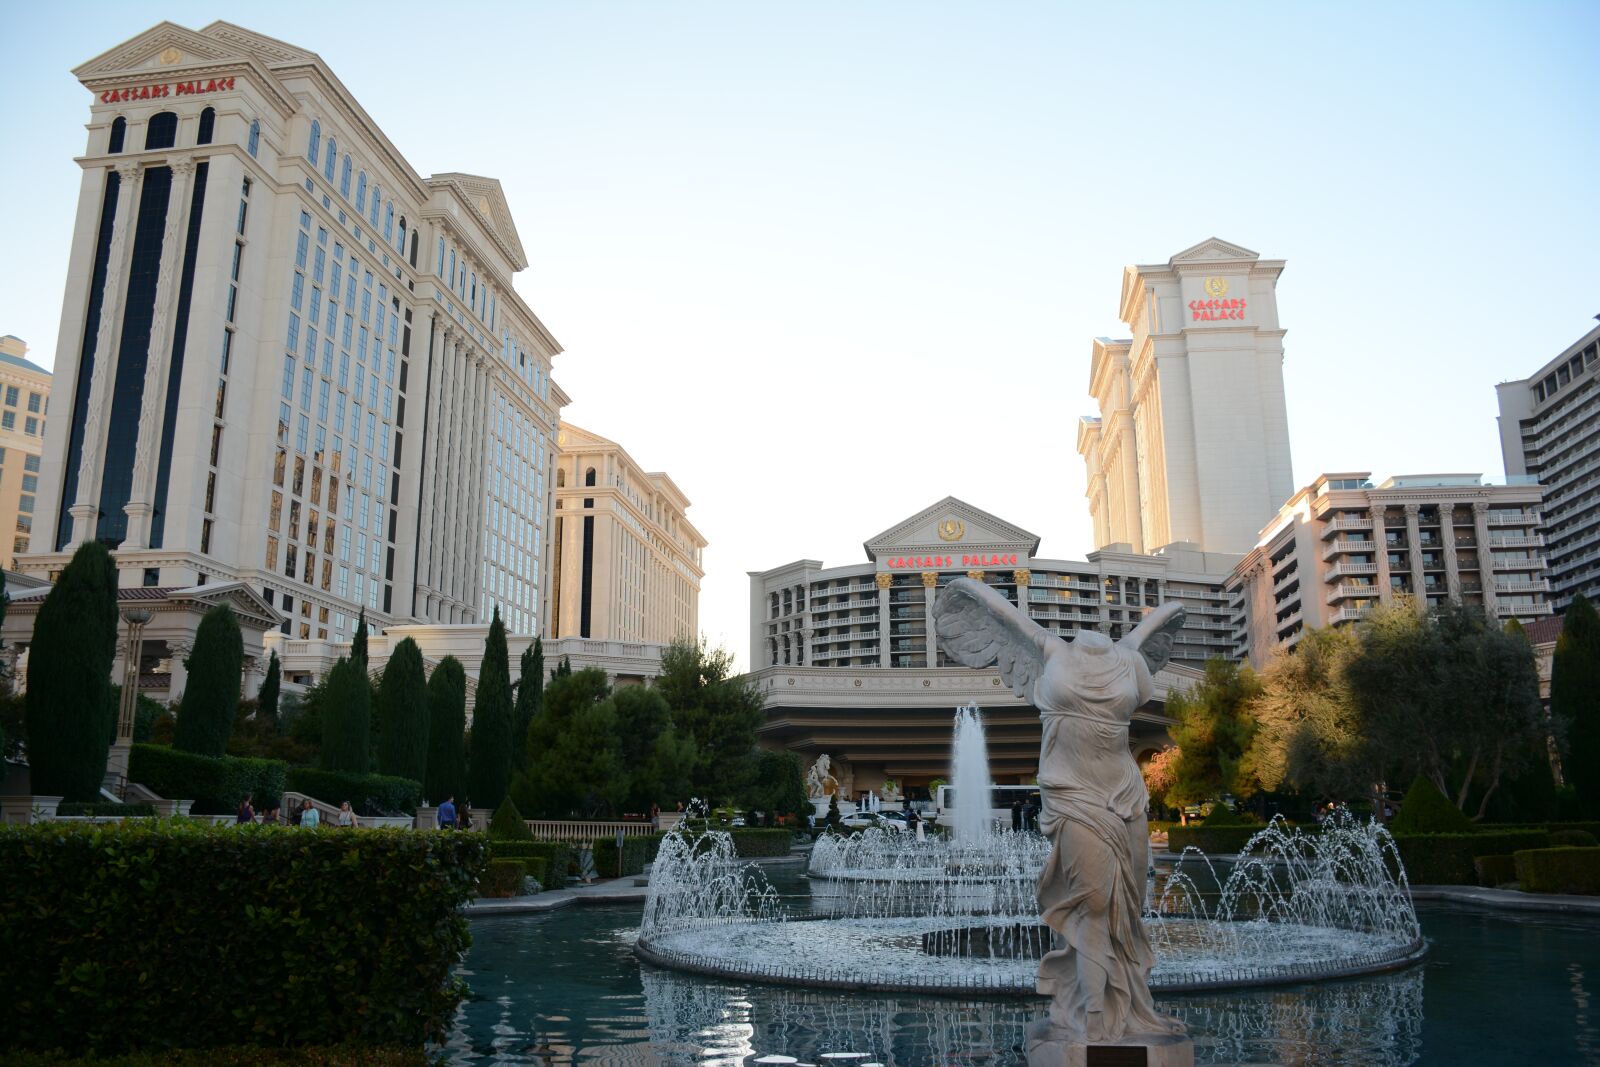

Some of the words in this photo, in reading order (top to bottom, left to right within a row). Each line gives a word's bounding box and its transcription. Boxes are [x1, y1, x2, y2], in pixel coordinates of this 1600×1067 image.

[100, 84, 169, 104] CAESARS
[176, 76, 235, 96] PALACE
[1189, 298, 1247, 310] CAESARS
[1193, 310, 1245, 321] PALACE
[887, 555, 952, 568] CAESARS
[962, 553, 1018, 567] PALACE
